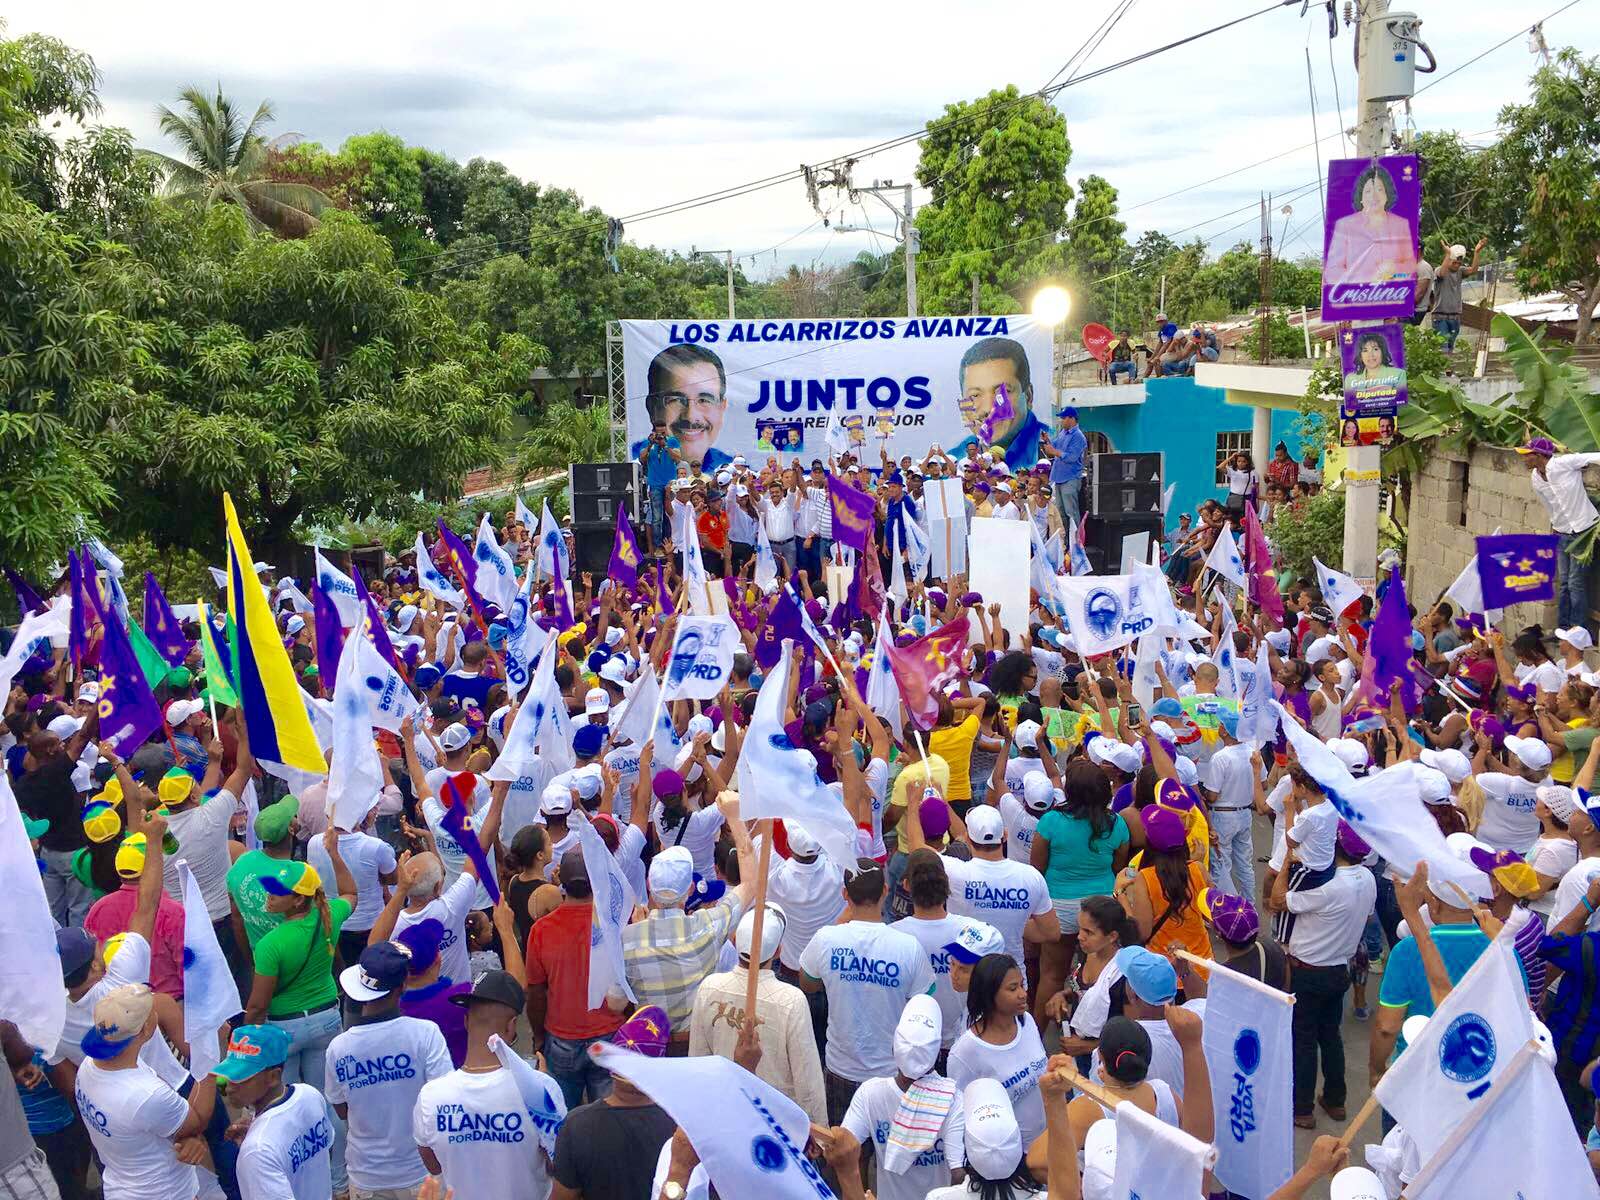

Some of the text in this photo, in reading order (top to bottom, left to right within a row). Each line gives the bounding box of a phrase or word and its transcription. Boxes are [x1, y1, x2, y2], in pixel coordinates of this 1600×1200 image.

[1328, 280, 1411, 303] Cristina
[669, 317, 1009, 343] LOS ALCARRIZOS AVANZA
[748, 376, 932, 413] JUNTOS
[765, 625, 774, 641] PLD
[1121, 617, 1153, 634] PRD
[688, 664, 722, 680] PRD
[965, 888, 1029, 901] BLANCO
[831, 948, 855, 956] VOTA
[830, 956, 899, 978] BLANCO
[336, 1055, 357, 1068] VOTA
[336, 1053, 411, 1082] BLANCO
[1001, 1067, 1030, 1089] unior
[436, 1104, 465, 1114] VOTA
[1230, 1072, 1247, 1143] PRD
[1243, 1082, 1256, 1132] VOTA
[436, 1112, 522, 1132] BLANCO
